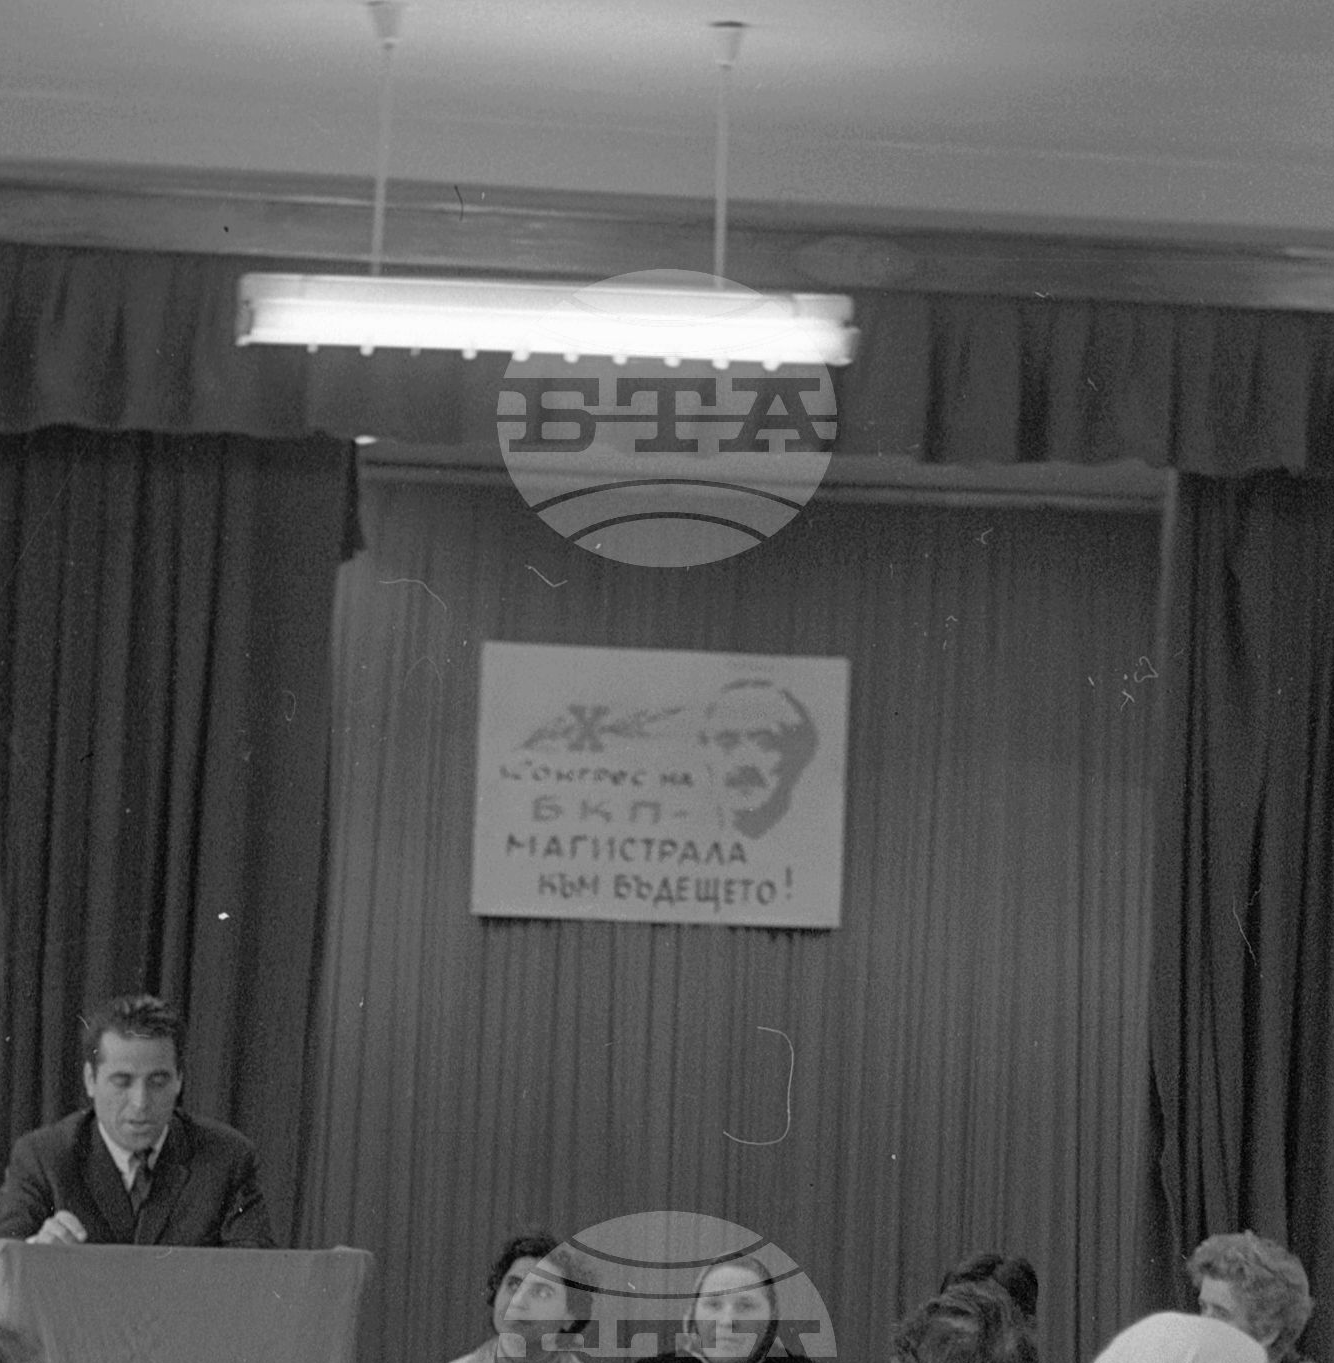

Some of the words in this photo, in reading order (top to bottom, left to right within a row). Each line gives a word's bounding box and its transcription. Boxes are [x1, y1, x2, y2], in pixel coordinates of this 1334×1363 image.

[505, 833, 748, 865] МАГИСТРАЛА
[538, 873, 599, 898] КЪМ
[613, 865, 793, 913] БЪДЕЩЕТО!
